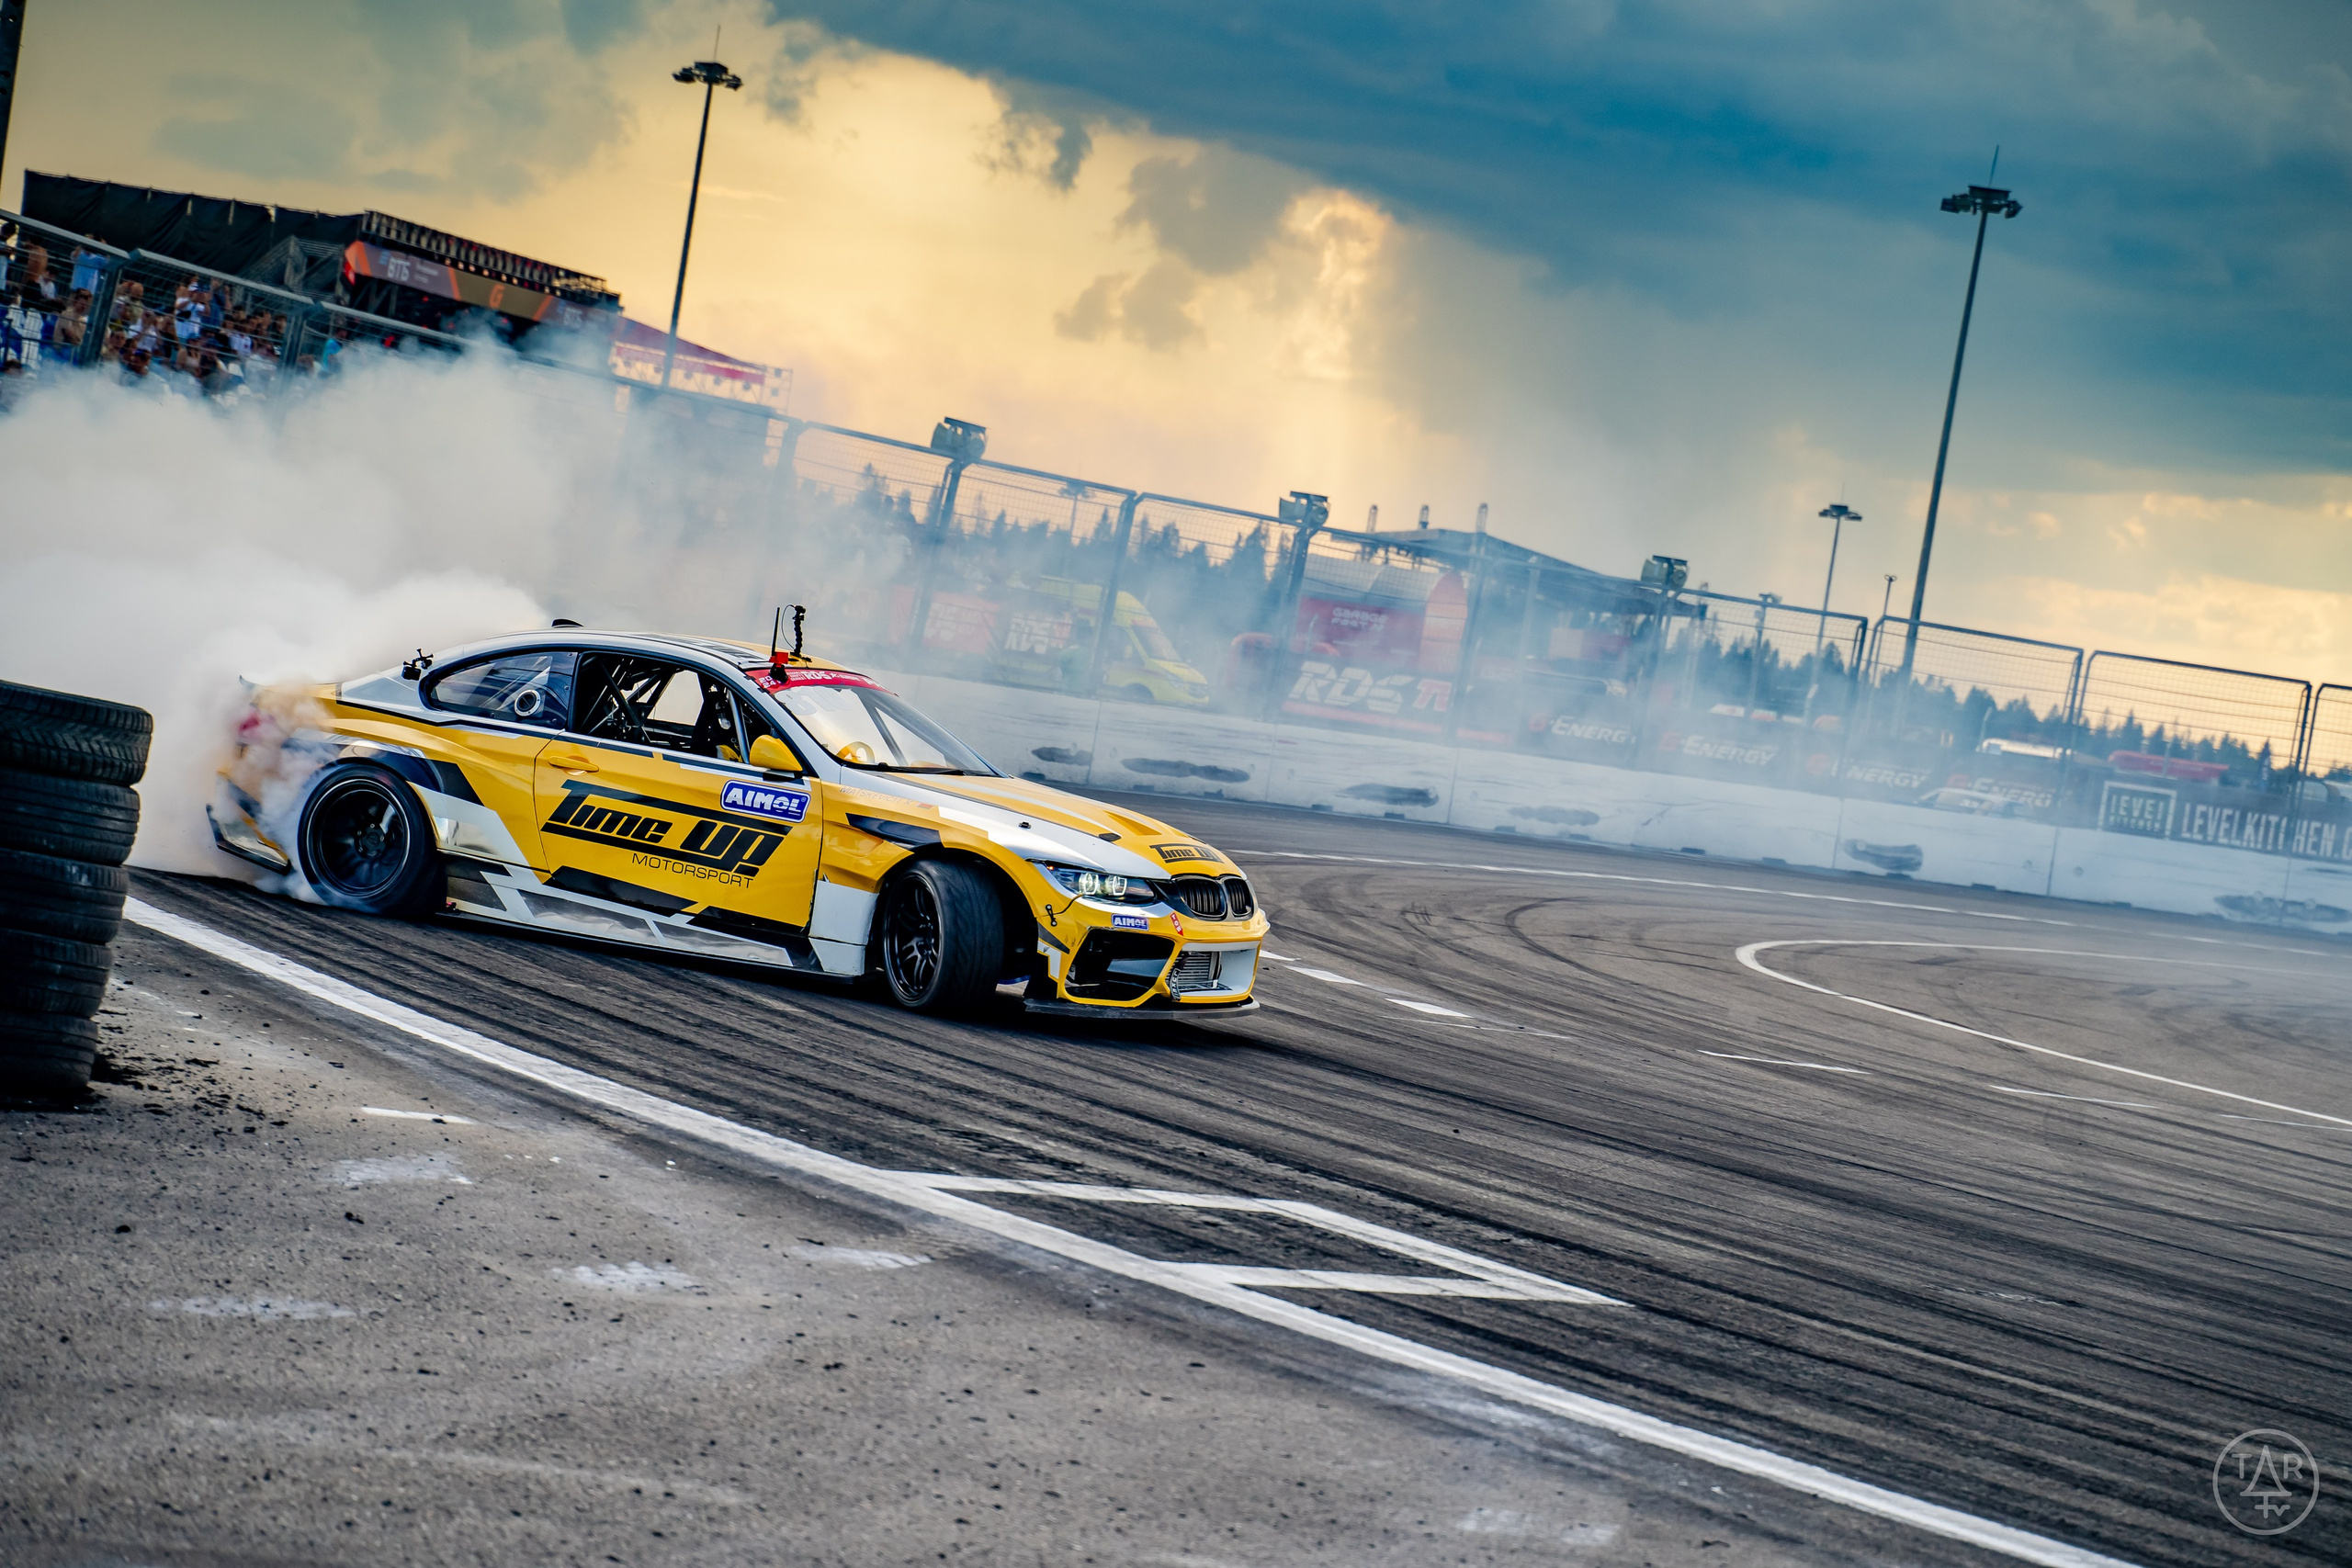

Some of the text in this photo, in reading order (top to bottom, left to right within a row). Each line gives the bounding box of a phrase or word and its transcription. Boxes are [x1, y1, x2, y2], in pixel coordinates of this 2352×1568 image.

[800, 671, 832, 680] RDS
[1288, 660, 1416, 715] RDS
[1529, 712, 1636, 745] G-ENERG
[632, 852, 753, 889] MOTORSPORT
[1171, 914, 1182, 932] TOW
